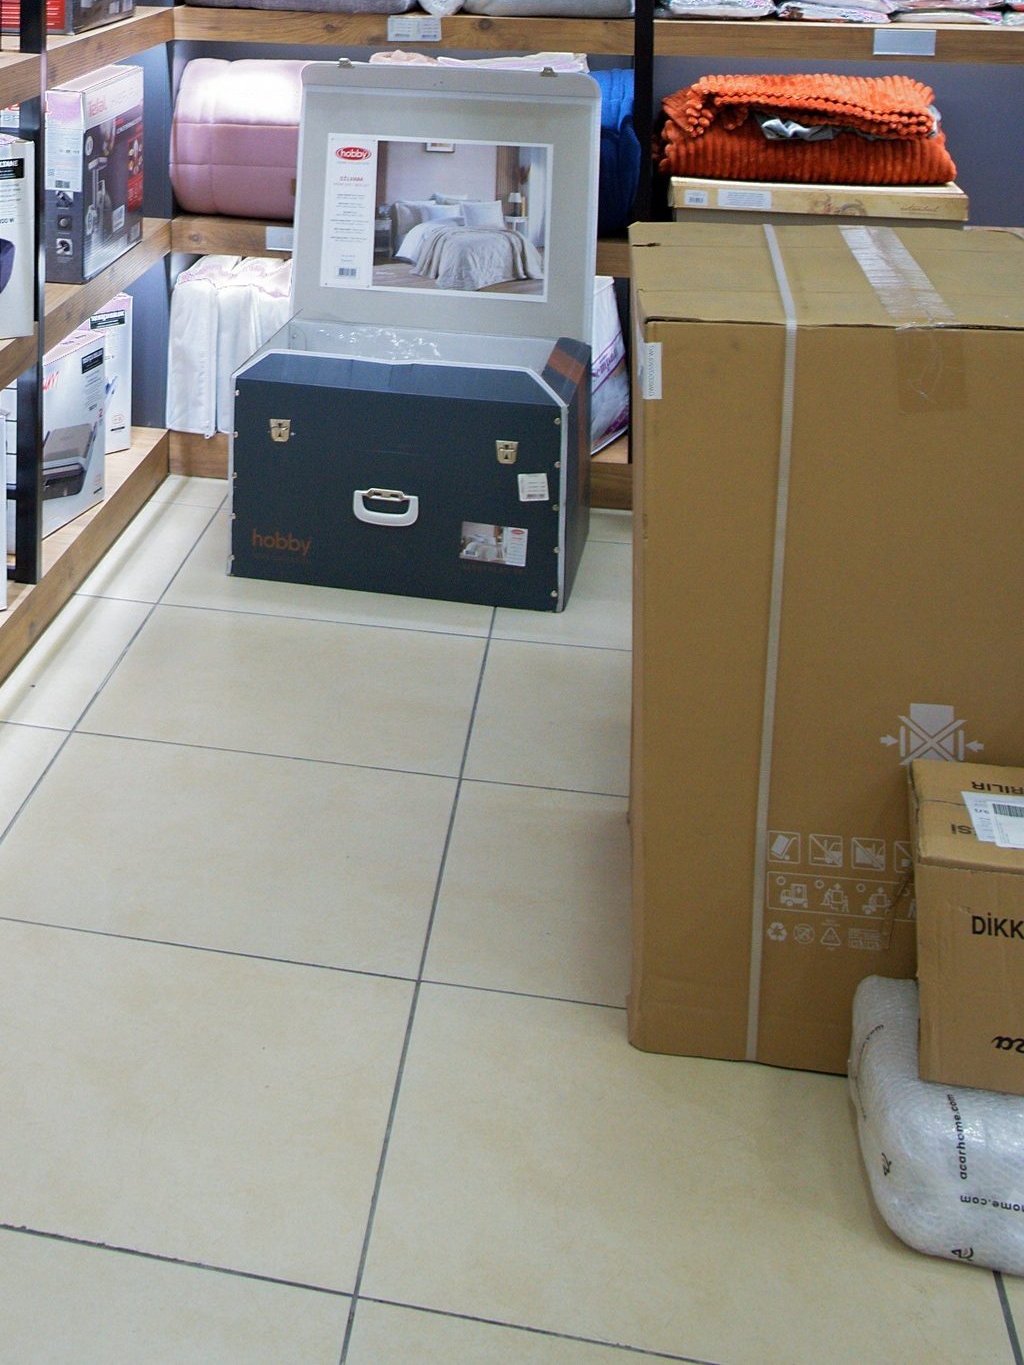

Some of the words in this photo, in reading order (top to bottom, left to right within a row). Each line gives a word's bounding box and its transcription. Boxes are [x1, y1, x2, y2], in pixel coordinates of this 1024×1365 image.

[339, 148, 368, 161] hobby
[252, 528, 313, 556] hobby
[972, 912, 1024, 941] DİKK
[946, 1093, 968, 1180] acarhome.com
